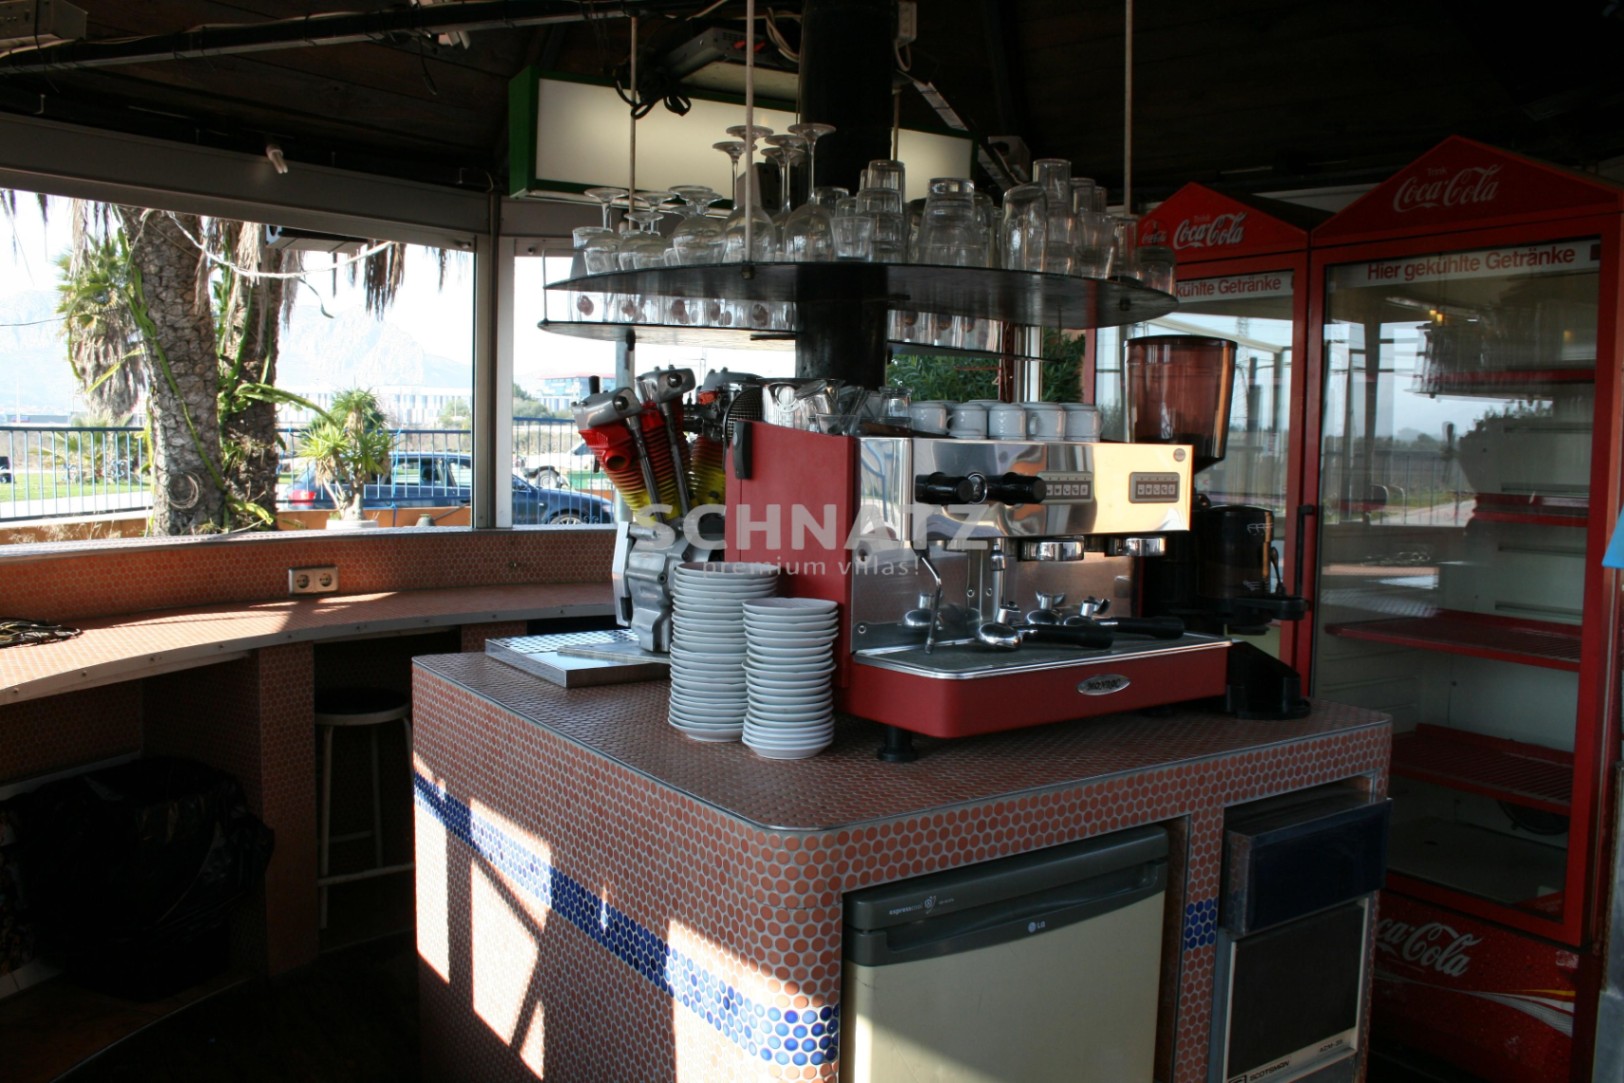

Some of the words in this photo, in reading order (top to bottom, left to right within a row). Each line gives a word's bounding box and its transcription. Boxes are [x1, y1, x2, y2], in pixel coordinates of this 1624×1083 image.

[1393, 163, 1504, 213] Coca-Cola
[1173, 211, 1248, 250] Coca-Cola
[1368, 263, 1401, 281] Hier
[1405, 255, 1480, 281] gekühlte
[1485, 246, 1575, 270] Getränke
[1176, 277, 1215, 298] kühlte
[1218, 275, 1281, 294] Getränke
[1376, 918, 1484, 977] ca-Cola
